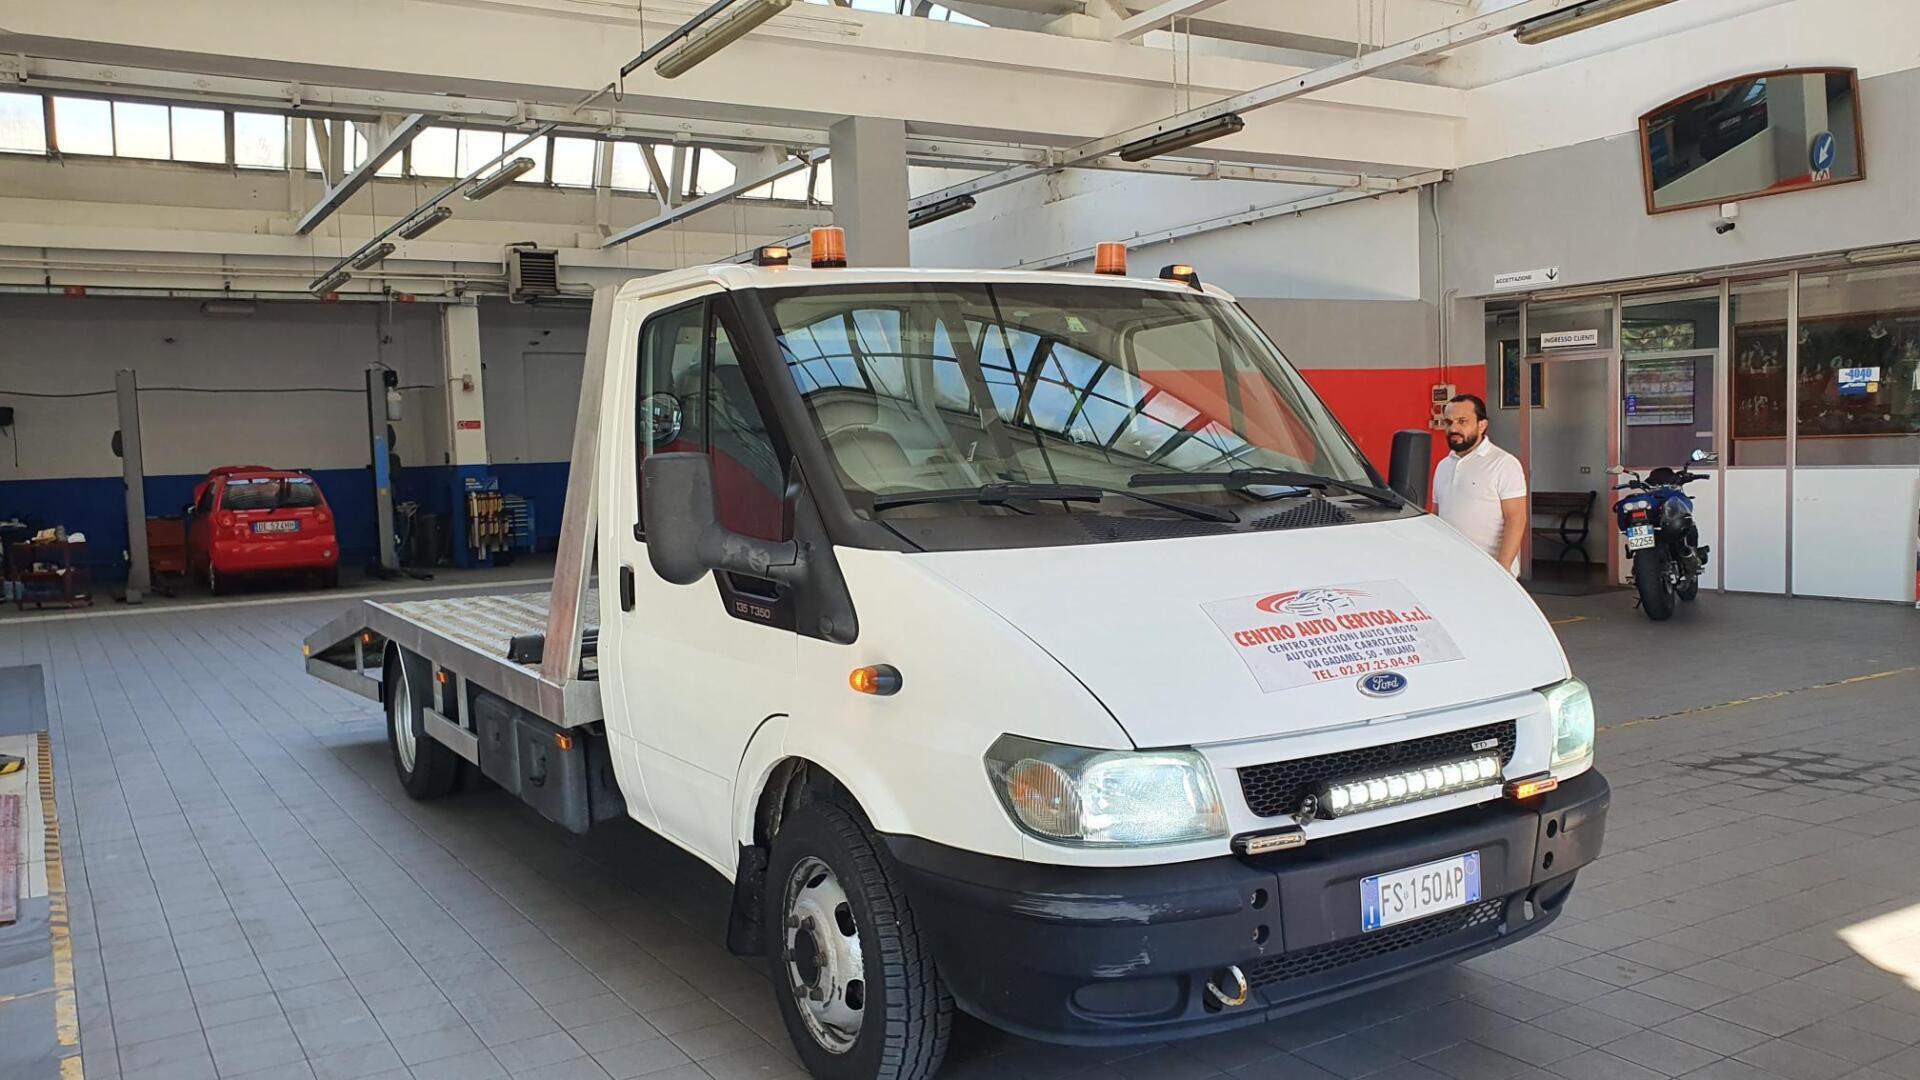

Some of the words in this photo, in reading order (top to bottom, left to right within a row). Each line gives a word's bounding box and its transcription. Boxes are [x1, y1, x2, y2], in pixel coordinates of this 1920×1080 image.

[1495, 274, 1532, 284] ACCETTAZIONE
[1543, 335, 1573, 344] INGRESSO
[1574, 334, 1595, 342] CLIENTI
[1633, 527, 1644, 536] AS
[735, 601, 749, 613] 135
[750, 605, 771, 619] T350
[1234, 624, 1296, 648] CENTRO
[1299, 616, 1336, 637] AUTO
[1336, 609, 1402, 631] CERTOSA
[1402, 606, 1432, 623] s.r.l.
[1267, 638, 1308, 654] CENTRO
[1308, 632, 1360, 648] REVISIONI
[1360, 628, 1384, 640] AUTO
[1384, 627, 1391, 636] E
[1391, 624, 1418, 635] MOTO
[1285, 643, 1351, 662] AUTOFFICINA
[1354, 635, 1417, 652] CARROZZERIA
[1303, 658, 1322, 670] VIA
[1322, 651, 1366, 668] GADAMES,
[1366, 650, 1377, 660] 50
[1384, 645, 1416, 657] MILANO
[1312, 667, 1338, 681] TEL.
[1372, 674, 1399, 691] Ford
